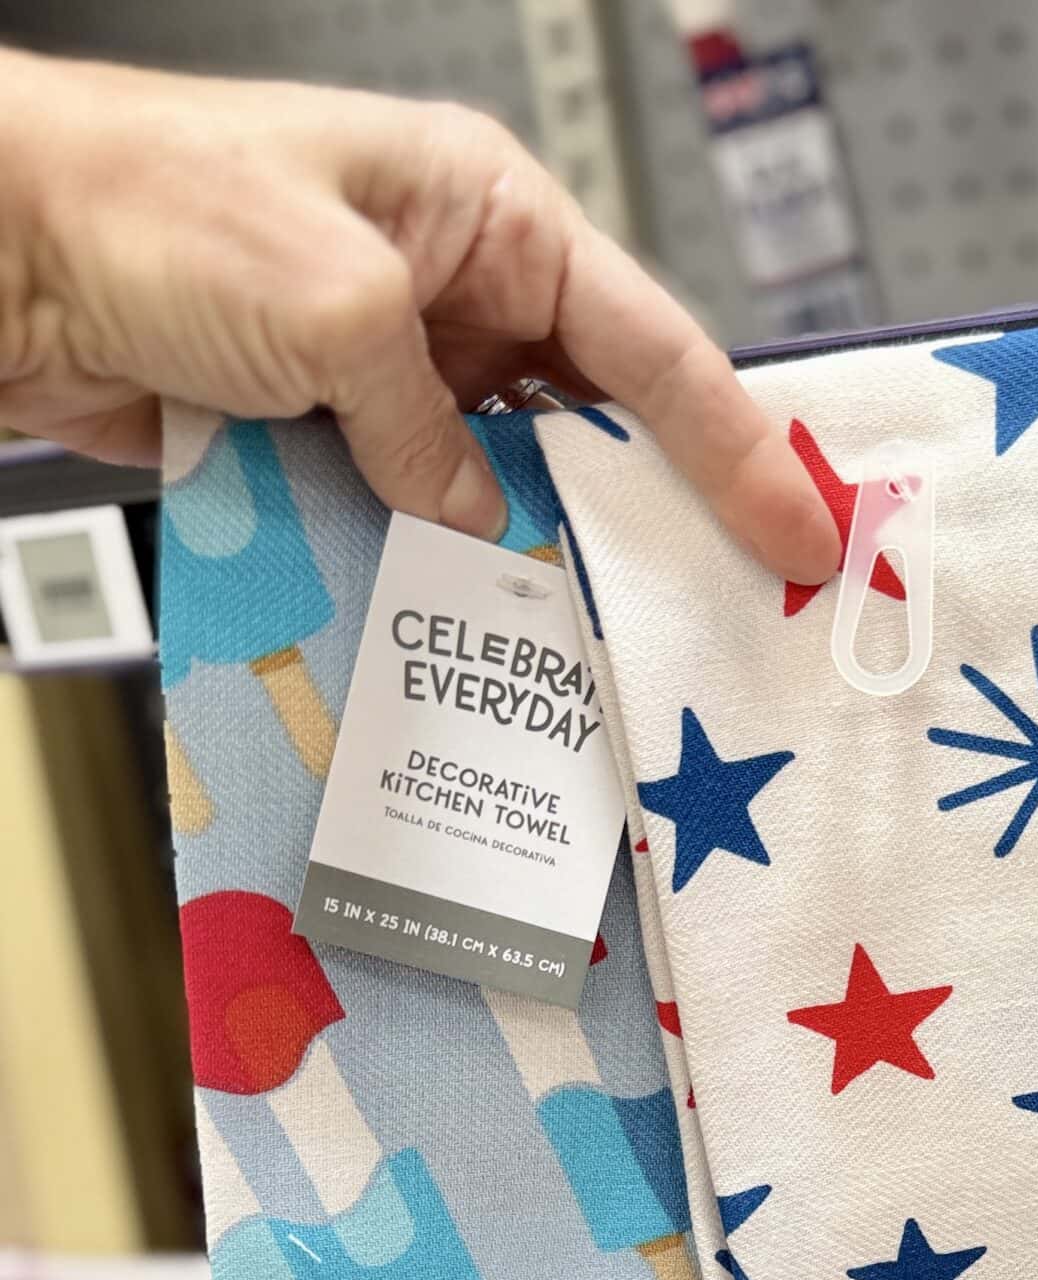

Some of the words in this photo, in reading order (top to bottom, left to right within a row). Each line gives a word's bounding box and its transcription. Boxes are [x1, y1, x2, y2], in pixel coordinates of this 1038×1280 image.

[391, 609, 604, 714] CELEBRA
[404, 660, 600, 752] EVERYDAY
[385, 806, 424, 828] TOALLA
[427, 820, 442, 833] DE
[495, 804, 571, 846] TOWEL
[323, 897, 340, 913] 15
[344, 902, 362, 922] IN
[364, 909, 376, 924] X
[379, 913, 399, 931] 25
[403, 919, 421, 937] IN
[424, 924, 458, 948] (38.1
[462, 937, 485, 954] CM
[488, 944, 499, 959] X
[502, 948, 534, 968] 63.5
[538, 959, 566, 978] CM)
